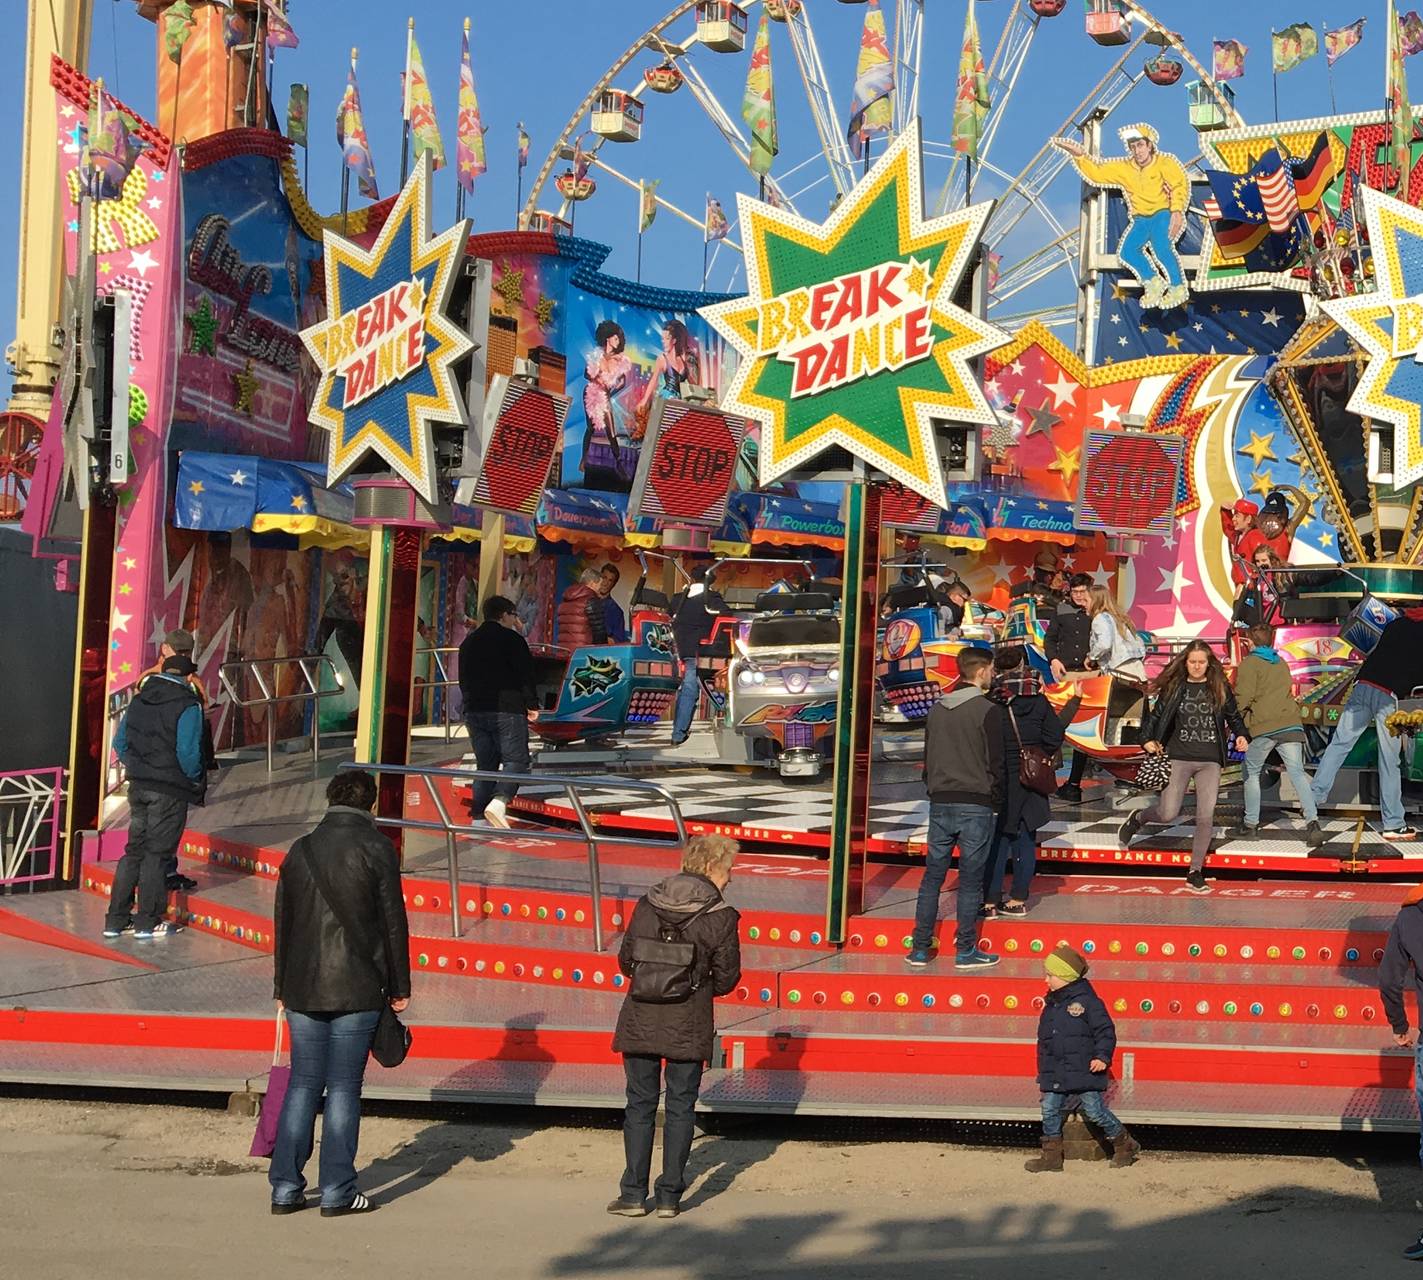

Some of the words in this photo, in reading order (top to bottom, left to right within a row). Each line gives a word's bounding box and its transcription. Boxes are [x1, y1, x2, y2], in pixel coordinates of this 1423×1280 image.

[327, 284, 410, 369] BREAK
[760, 265, 904, 352] BREAK
[342, 319, 425, 405] DANCE
[787, 305, 931, 393] DANCE
[113, 453, 123, 470] 6
[493, 424, 551, 466] STOP
[660, 441, 730, 486] STOP
[1092, 463, 1170, 498] STOP
[1021, 514, 1073, 532] Techno
[1316, 639, 1332, 656] 18
[1040, 849, 1090, 860] BREAK
[1114, 851, 1162, 863] DANCE
